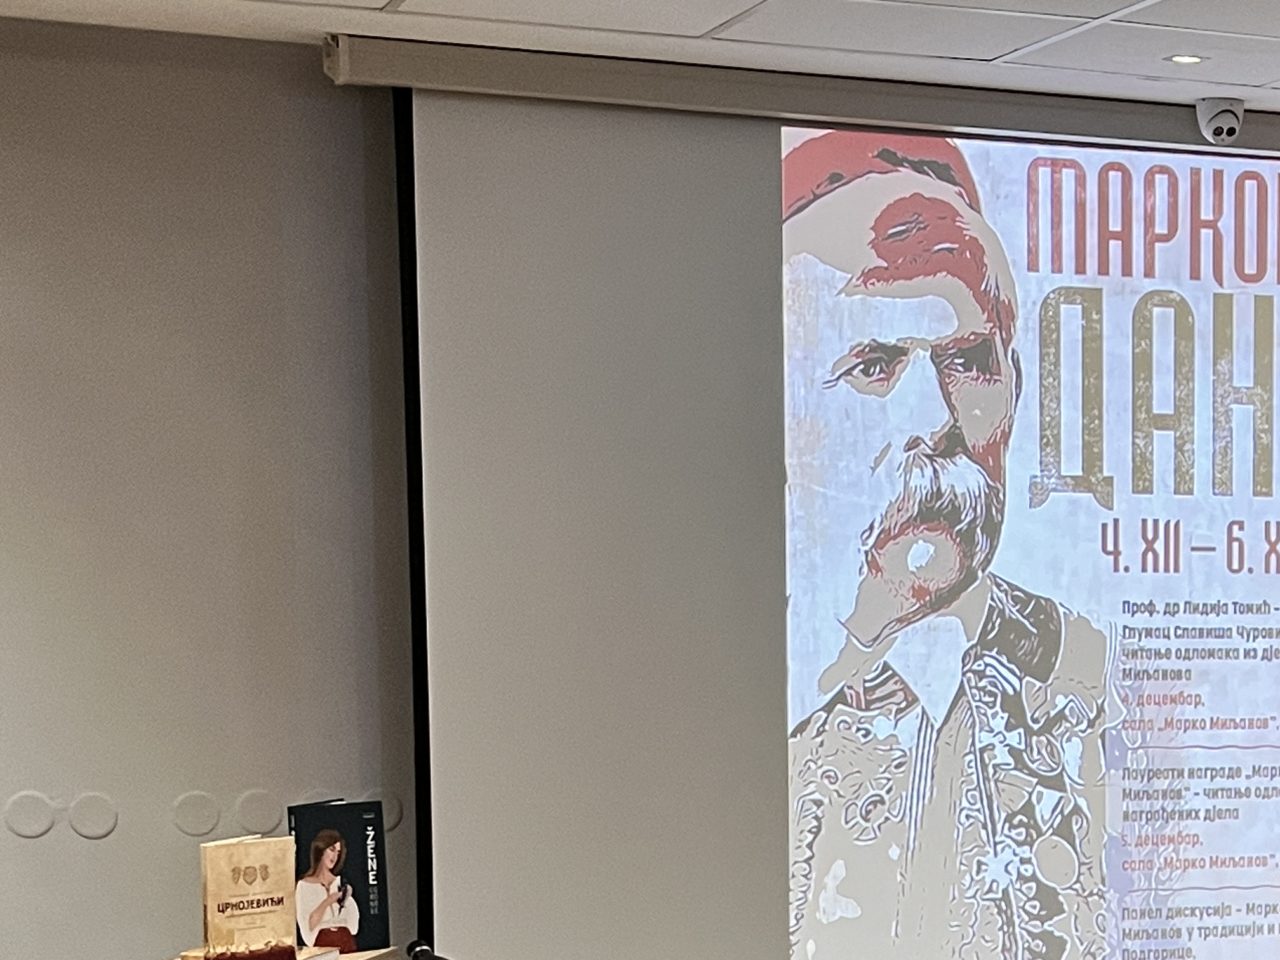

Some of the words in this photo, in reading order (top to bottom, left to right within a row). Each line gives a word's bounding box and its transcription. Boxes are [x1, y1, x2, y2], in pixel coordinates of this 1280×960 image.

[1101, 517, 1130, 574] 4.
[1226, 520, 1254, 575] 6.
[1122, 599, 1160, 618] Проф.
[1163, 602, 1180, 618] др
[1183, 600, 1229, 617] Лидија
[1232, 599, 1271, 615] Томић
[1122, 624, 1171, 643] Глумац
[1174, 625, 1233, 640] Славиша
[1122, 647, 1172, 661] читање
[1174, 647, 1240, 662] одломака
[1243, 647, 1258, 660] из
[1122, 667, 1192, 681] Миљанова
[1122, 719, 1154, 731] сала
[1122, 767, 1185, 783] Лауреати
[1187, 766, 1243, 782] награде
[1203, 786, 1252, 800] читање
[1122, 805, 1201, 824] награђених
[1203, 804, 1240, 823] дјела
[366, 826, 378, 885] ŽENE
[1122, 859, 1153, 872] сала
[1122, 907, 1163, 921] Панел
[1165, 902, 1233, 921] дискусија
[1122, 927, 1183, 942] Миљанов
[1196, 921, 1265, 941] традицији
[1267, 923, 1275, 935] и
